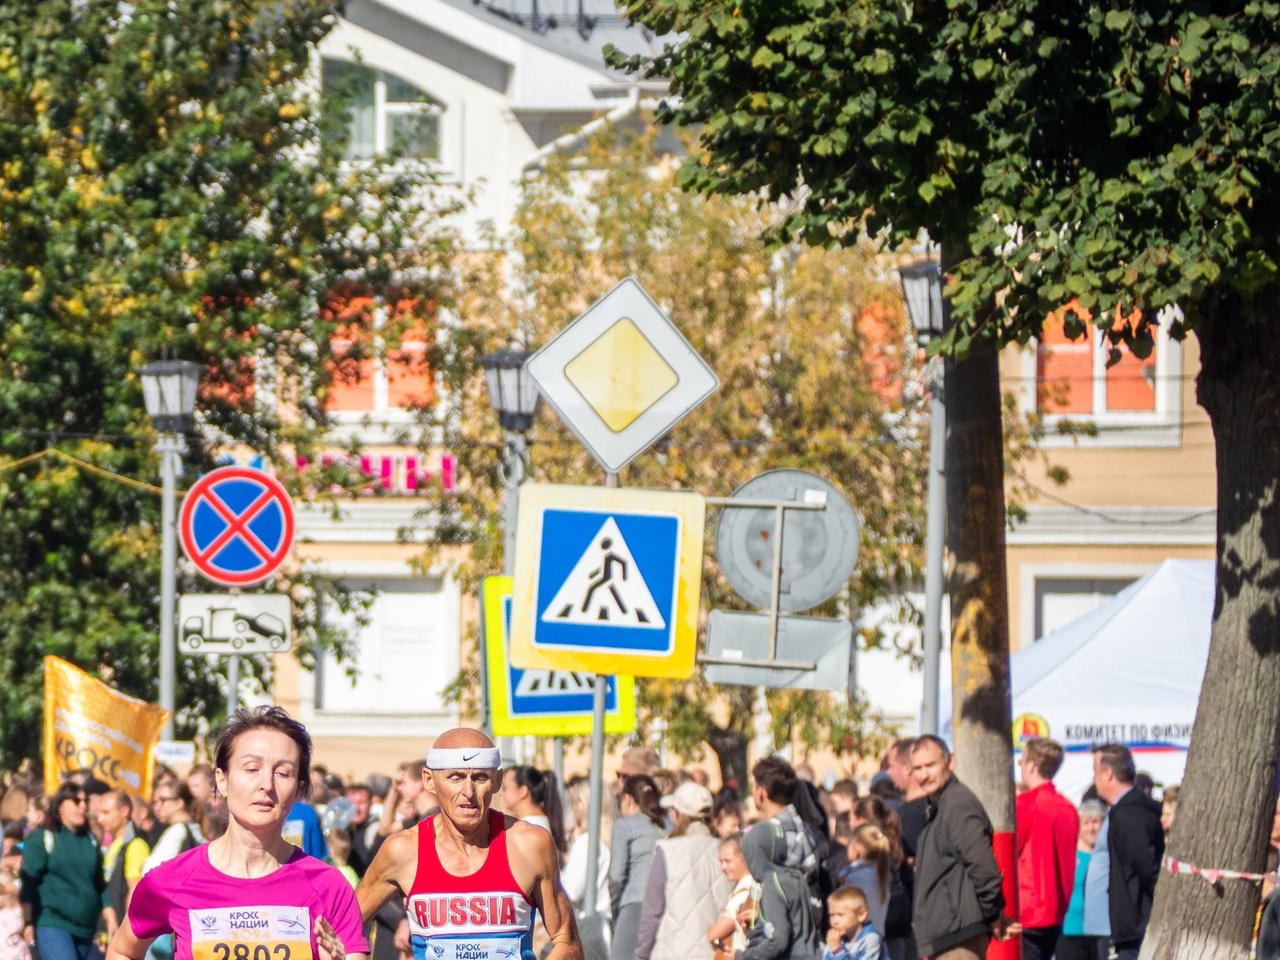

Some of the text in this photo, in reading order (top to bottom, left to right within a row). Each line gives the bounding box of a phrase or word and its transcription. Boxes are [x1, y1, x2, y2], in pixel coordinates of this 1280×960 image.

[1065, 723, 1192, 741] КОМИТЕТ ПО ФИЗИ
[229, 911, 259, 920] КРОСС
[413, 896, 517, 929] RUSSIA
[230, 919, 269, 929] НАЦИИ
[455, 943, 481, 951] КРОСС
[456, 951, 489, 960] НАЦИИ
